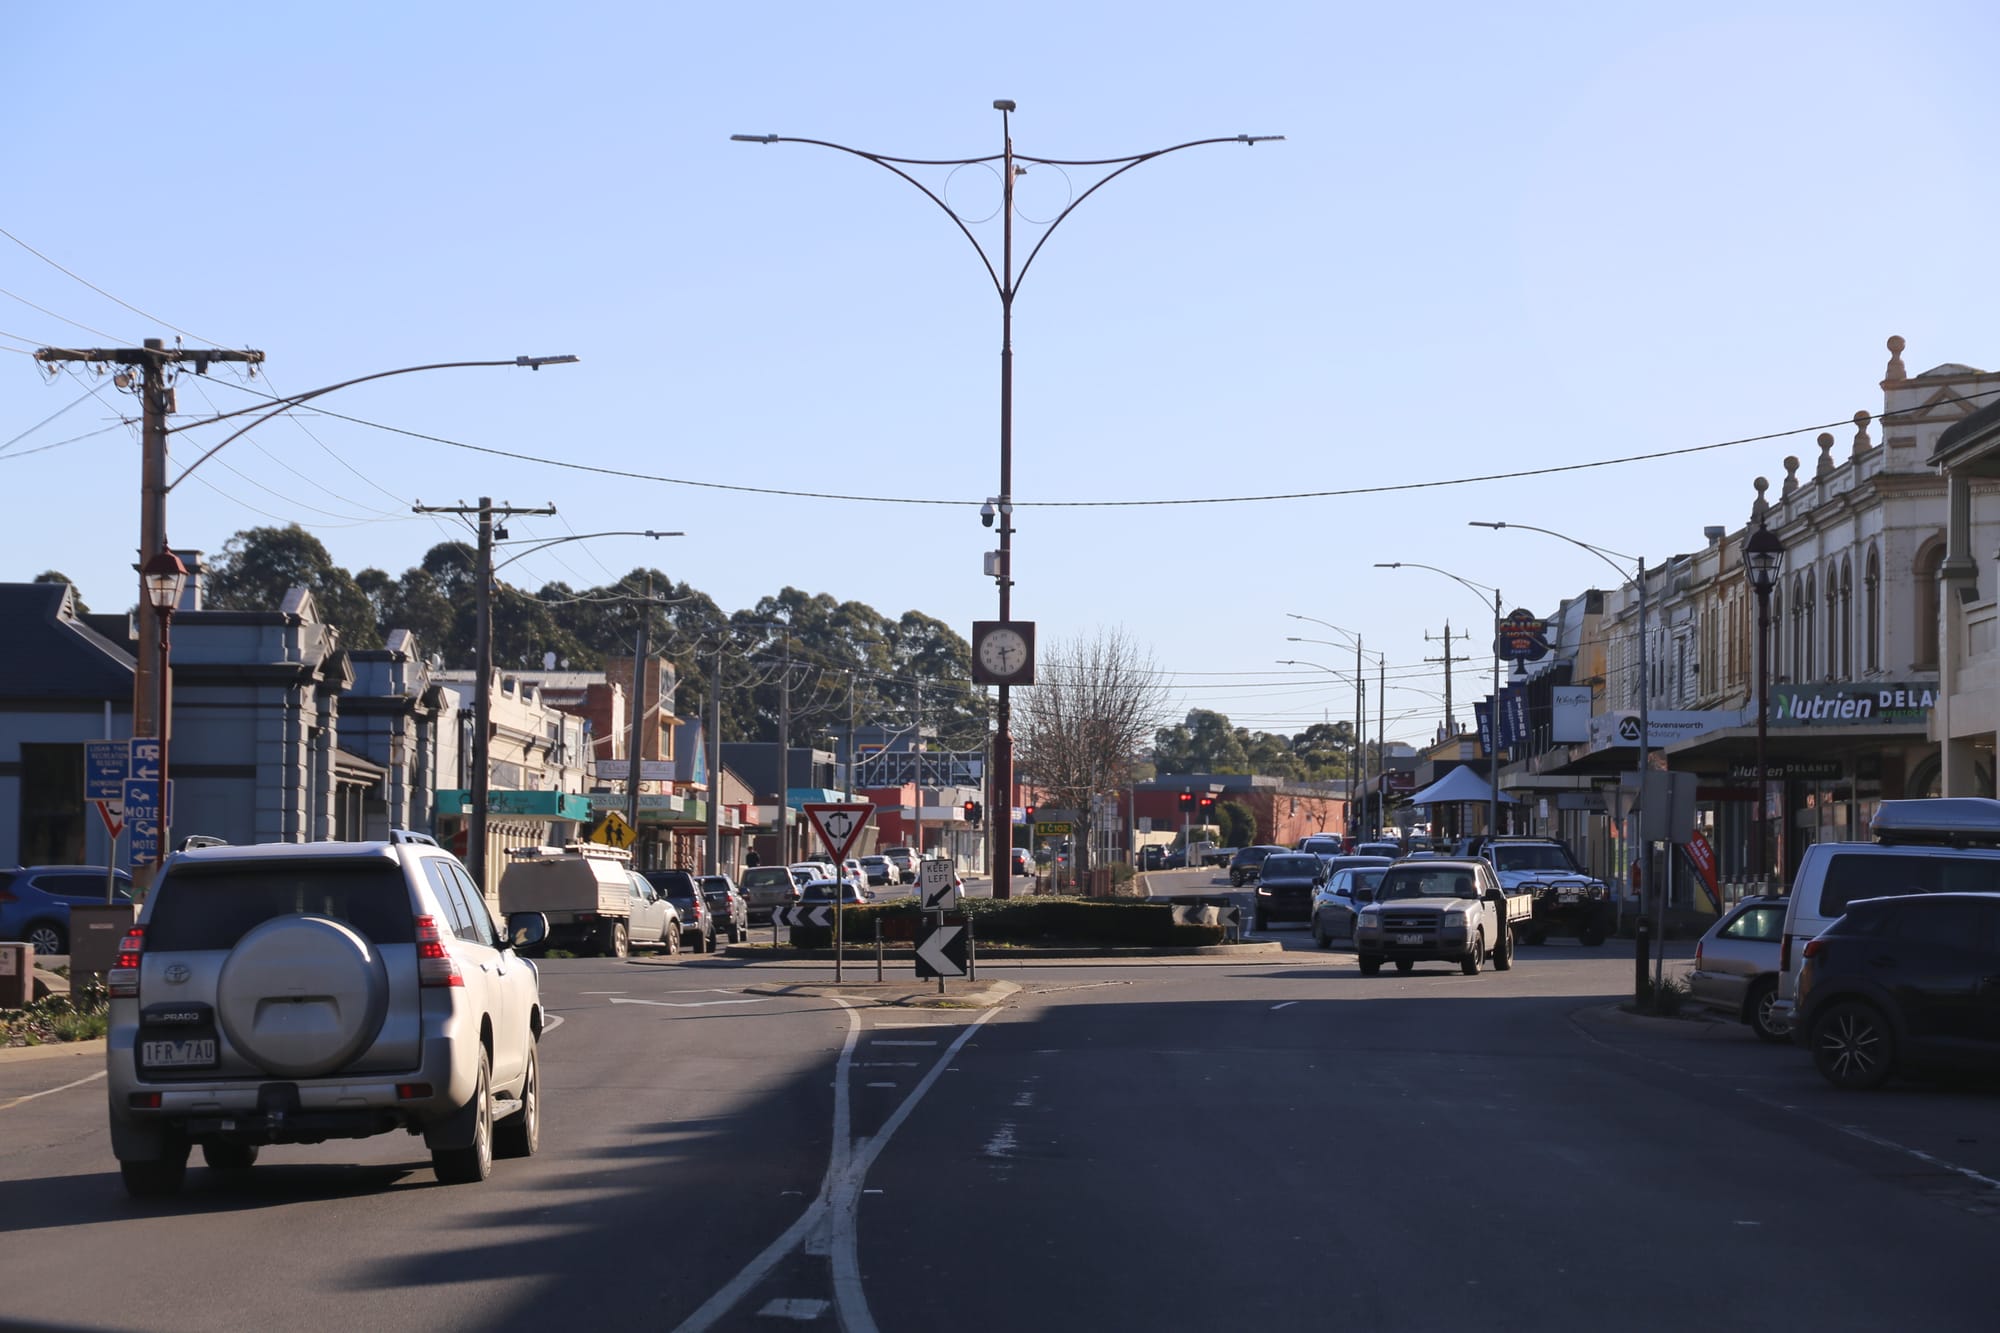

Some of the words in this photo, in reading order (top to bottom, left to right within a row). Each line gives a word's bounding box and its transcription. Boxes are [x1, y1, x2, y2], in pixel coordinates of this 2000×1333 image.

[1500, 621, 1542, 632] CLUB
[1776, 692, 1872, 719] Nutrien
[1879, 689, 1941, 708] DELA
[1515, 696, 1526, 737] BISTRO
[1480, 714, 1491, 753] BARS
[1786, 763, 1837, 773] DELANEY
[125, 806, 162, 818] MOTE
[132, 839, 158, 849] MOTE
[927, 863, 949, 873] KEEP
[928, 874, 949, 883] LEFT
[163, 1012, 199, 1020] PRADO
